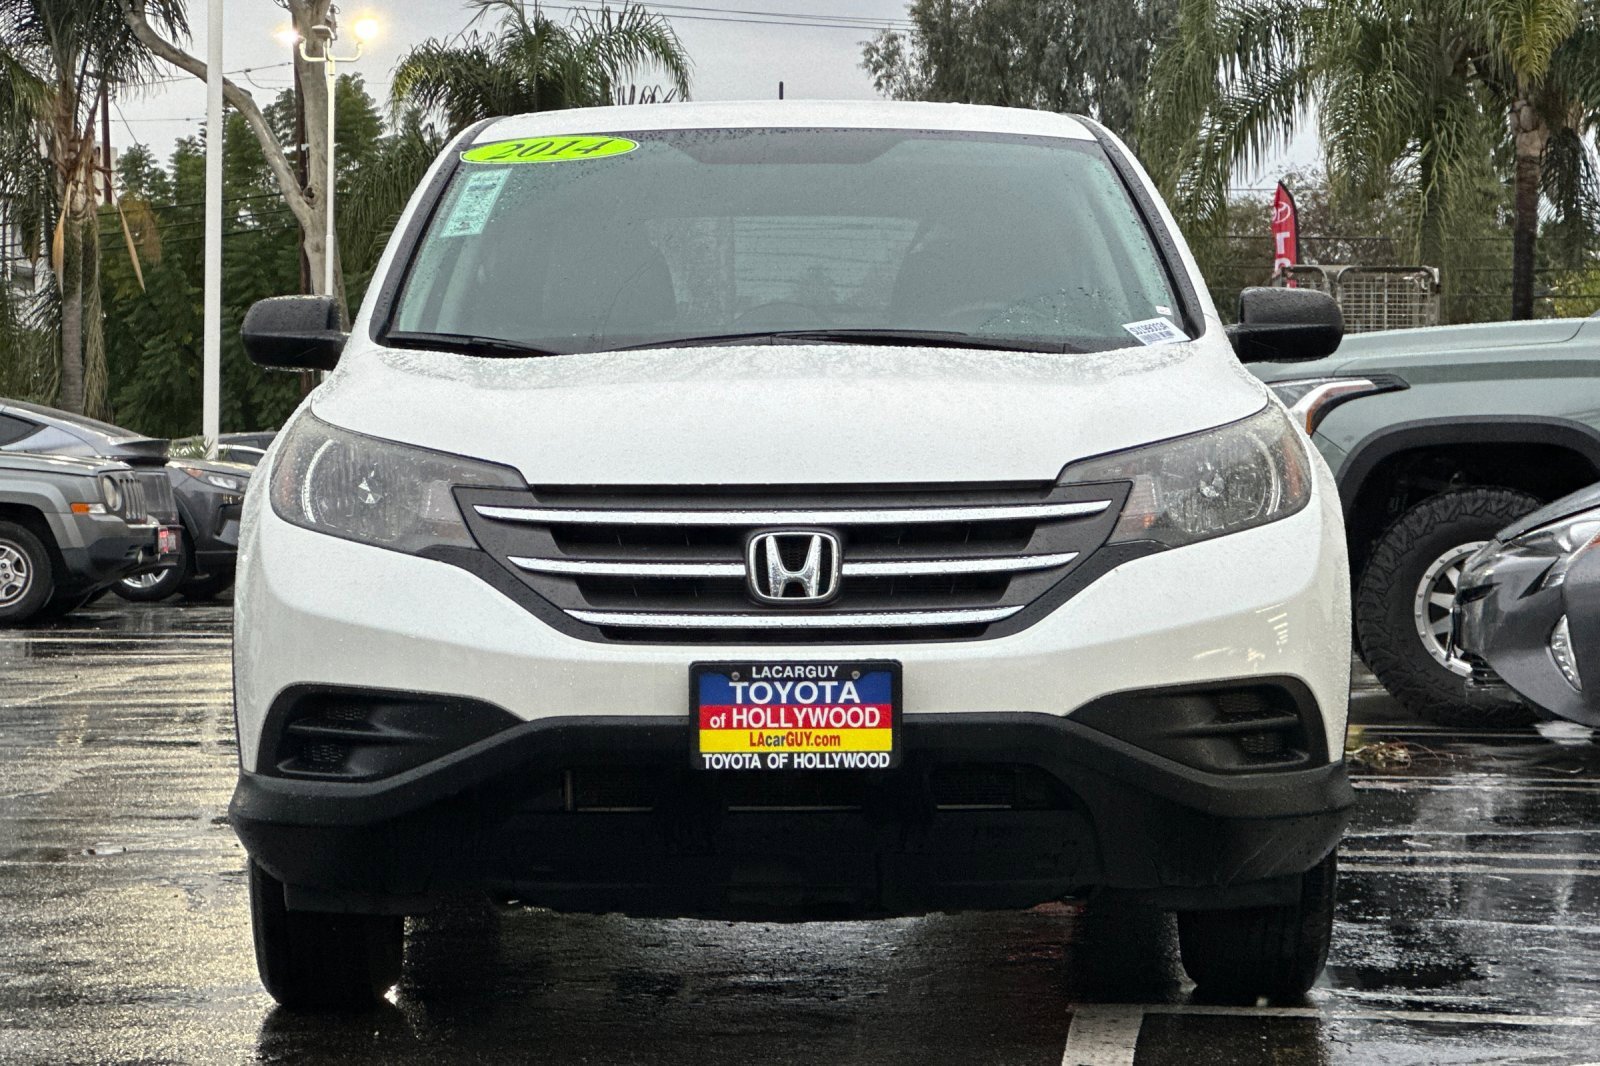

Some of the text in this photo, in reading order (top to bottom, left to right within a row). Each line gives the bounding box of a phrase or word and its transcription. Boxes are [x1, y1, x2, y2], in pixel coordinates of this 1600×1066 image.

[484, 139, 614, 160] 2014
[752, 665, 839, 679] LACARGUY
[729, 681, 861, 705] TOYOTA
[710, 706, 881, 728] of HOLLYWOOD
[749, 731, 841, 747] LAcarGUY.com
[703, 752, 890, 770] TOYOTA OF HOLLYWOOD
